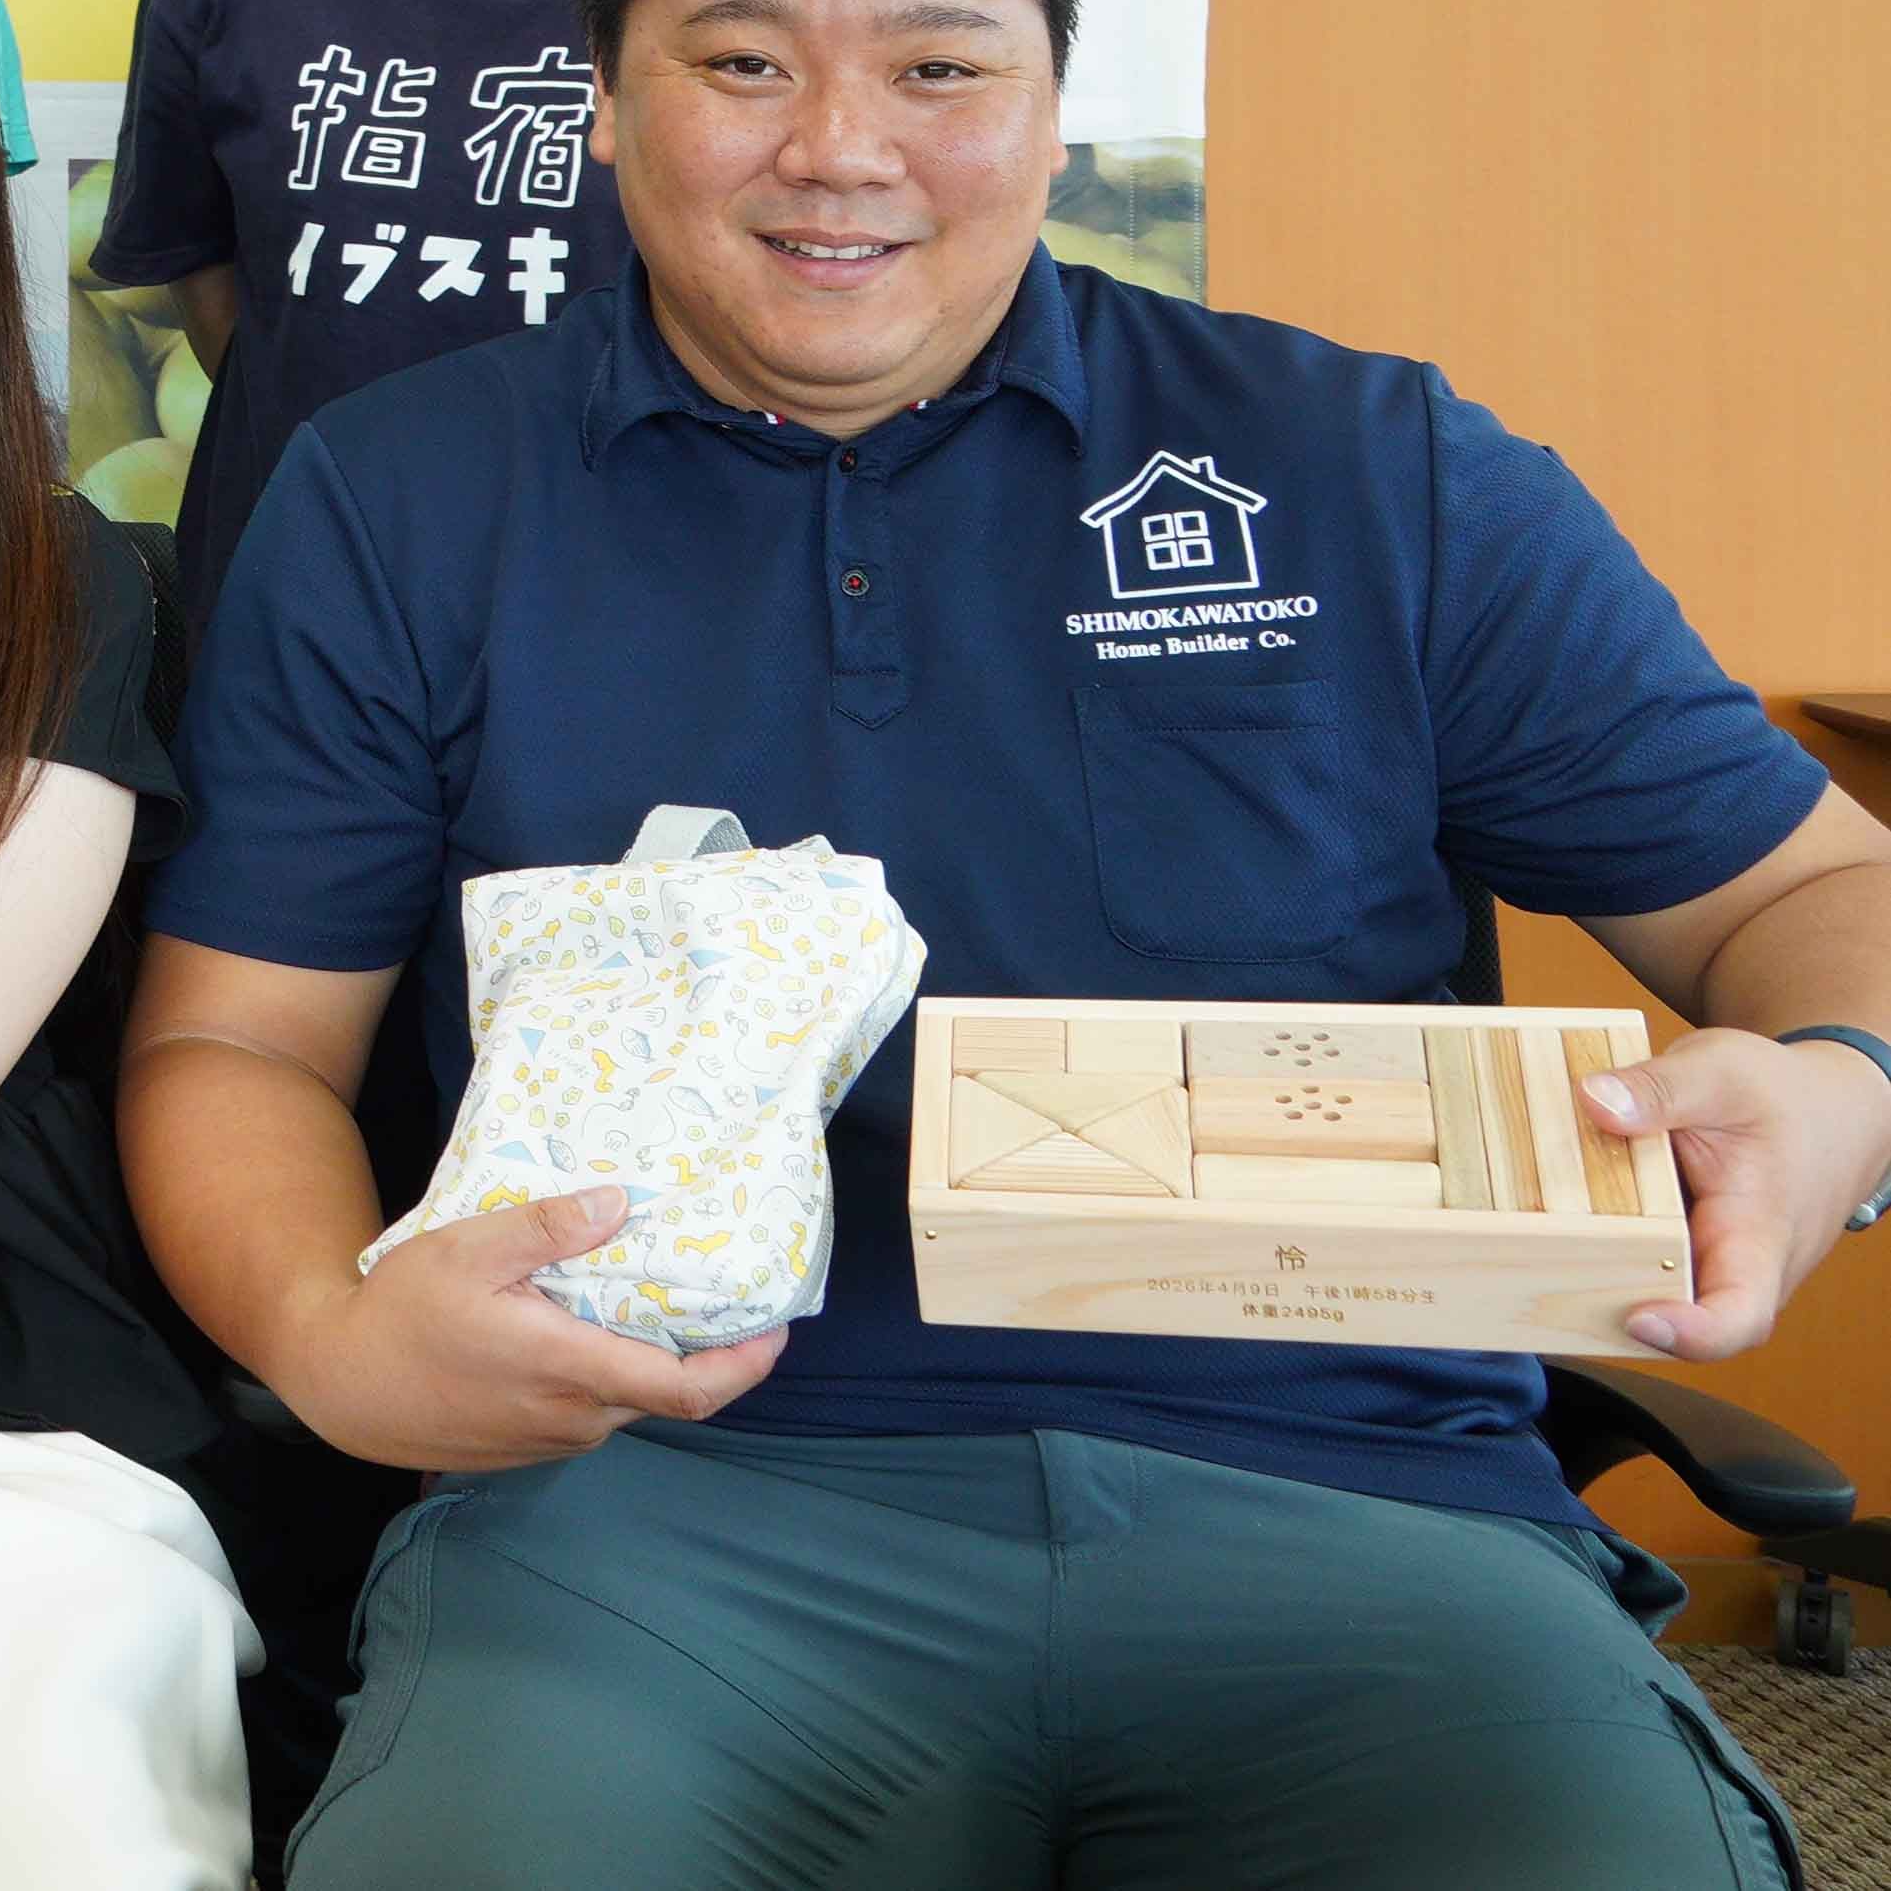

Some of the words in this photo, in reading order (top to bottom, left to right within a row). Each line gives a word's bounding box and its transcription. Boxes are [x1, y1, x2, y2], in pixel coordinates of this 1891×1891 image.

[288, 44, 596, 208] 指宿
[288, 222, 570, 326] イブスキ
[1066, 595, 1319, 635] SHIMOKAWATOKO
[1095, 642, 1162, 660] Home
[1166, 634, 1250, 655] Builder
[1259, 631, 1297, 649] Co.
